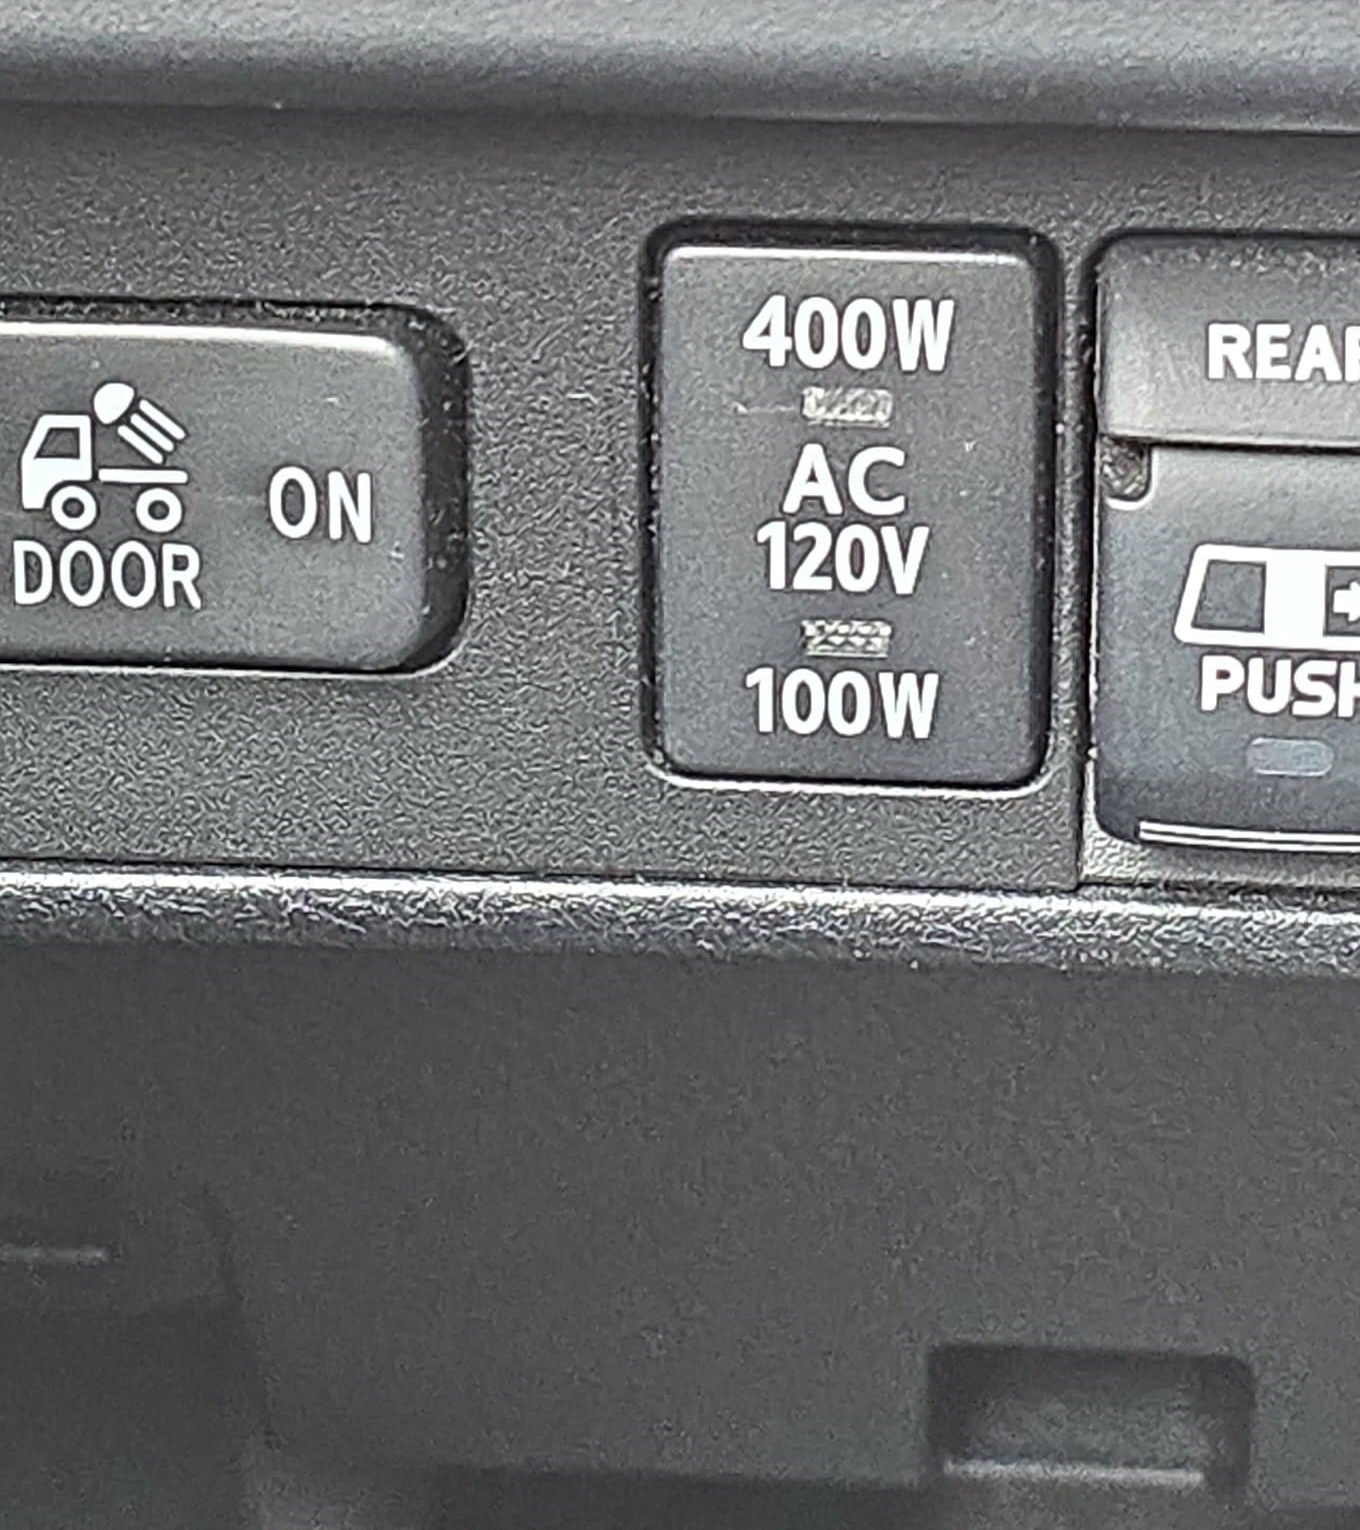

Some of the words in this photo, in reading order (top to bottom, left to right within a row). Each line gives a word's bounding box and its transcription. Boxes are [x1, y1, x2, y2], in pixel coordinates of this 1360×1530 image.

[741, 293, 956, 372] 400W
[268, 465, 373, 544] ON
[781, 442, 906, 517] AC
[12, 539, 203, 611] DOOR
[755, 520, 931, 596] 120V
[744, 666, 940, 740] 100W
